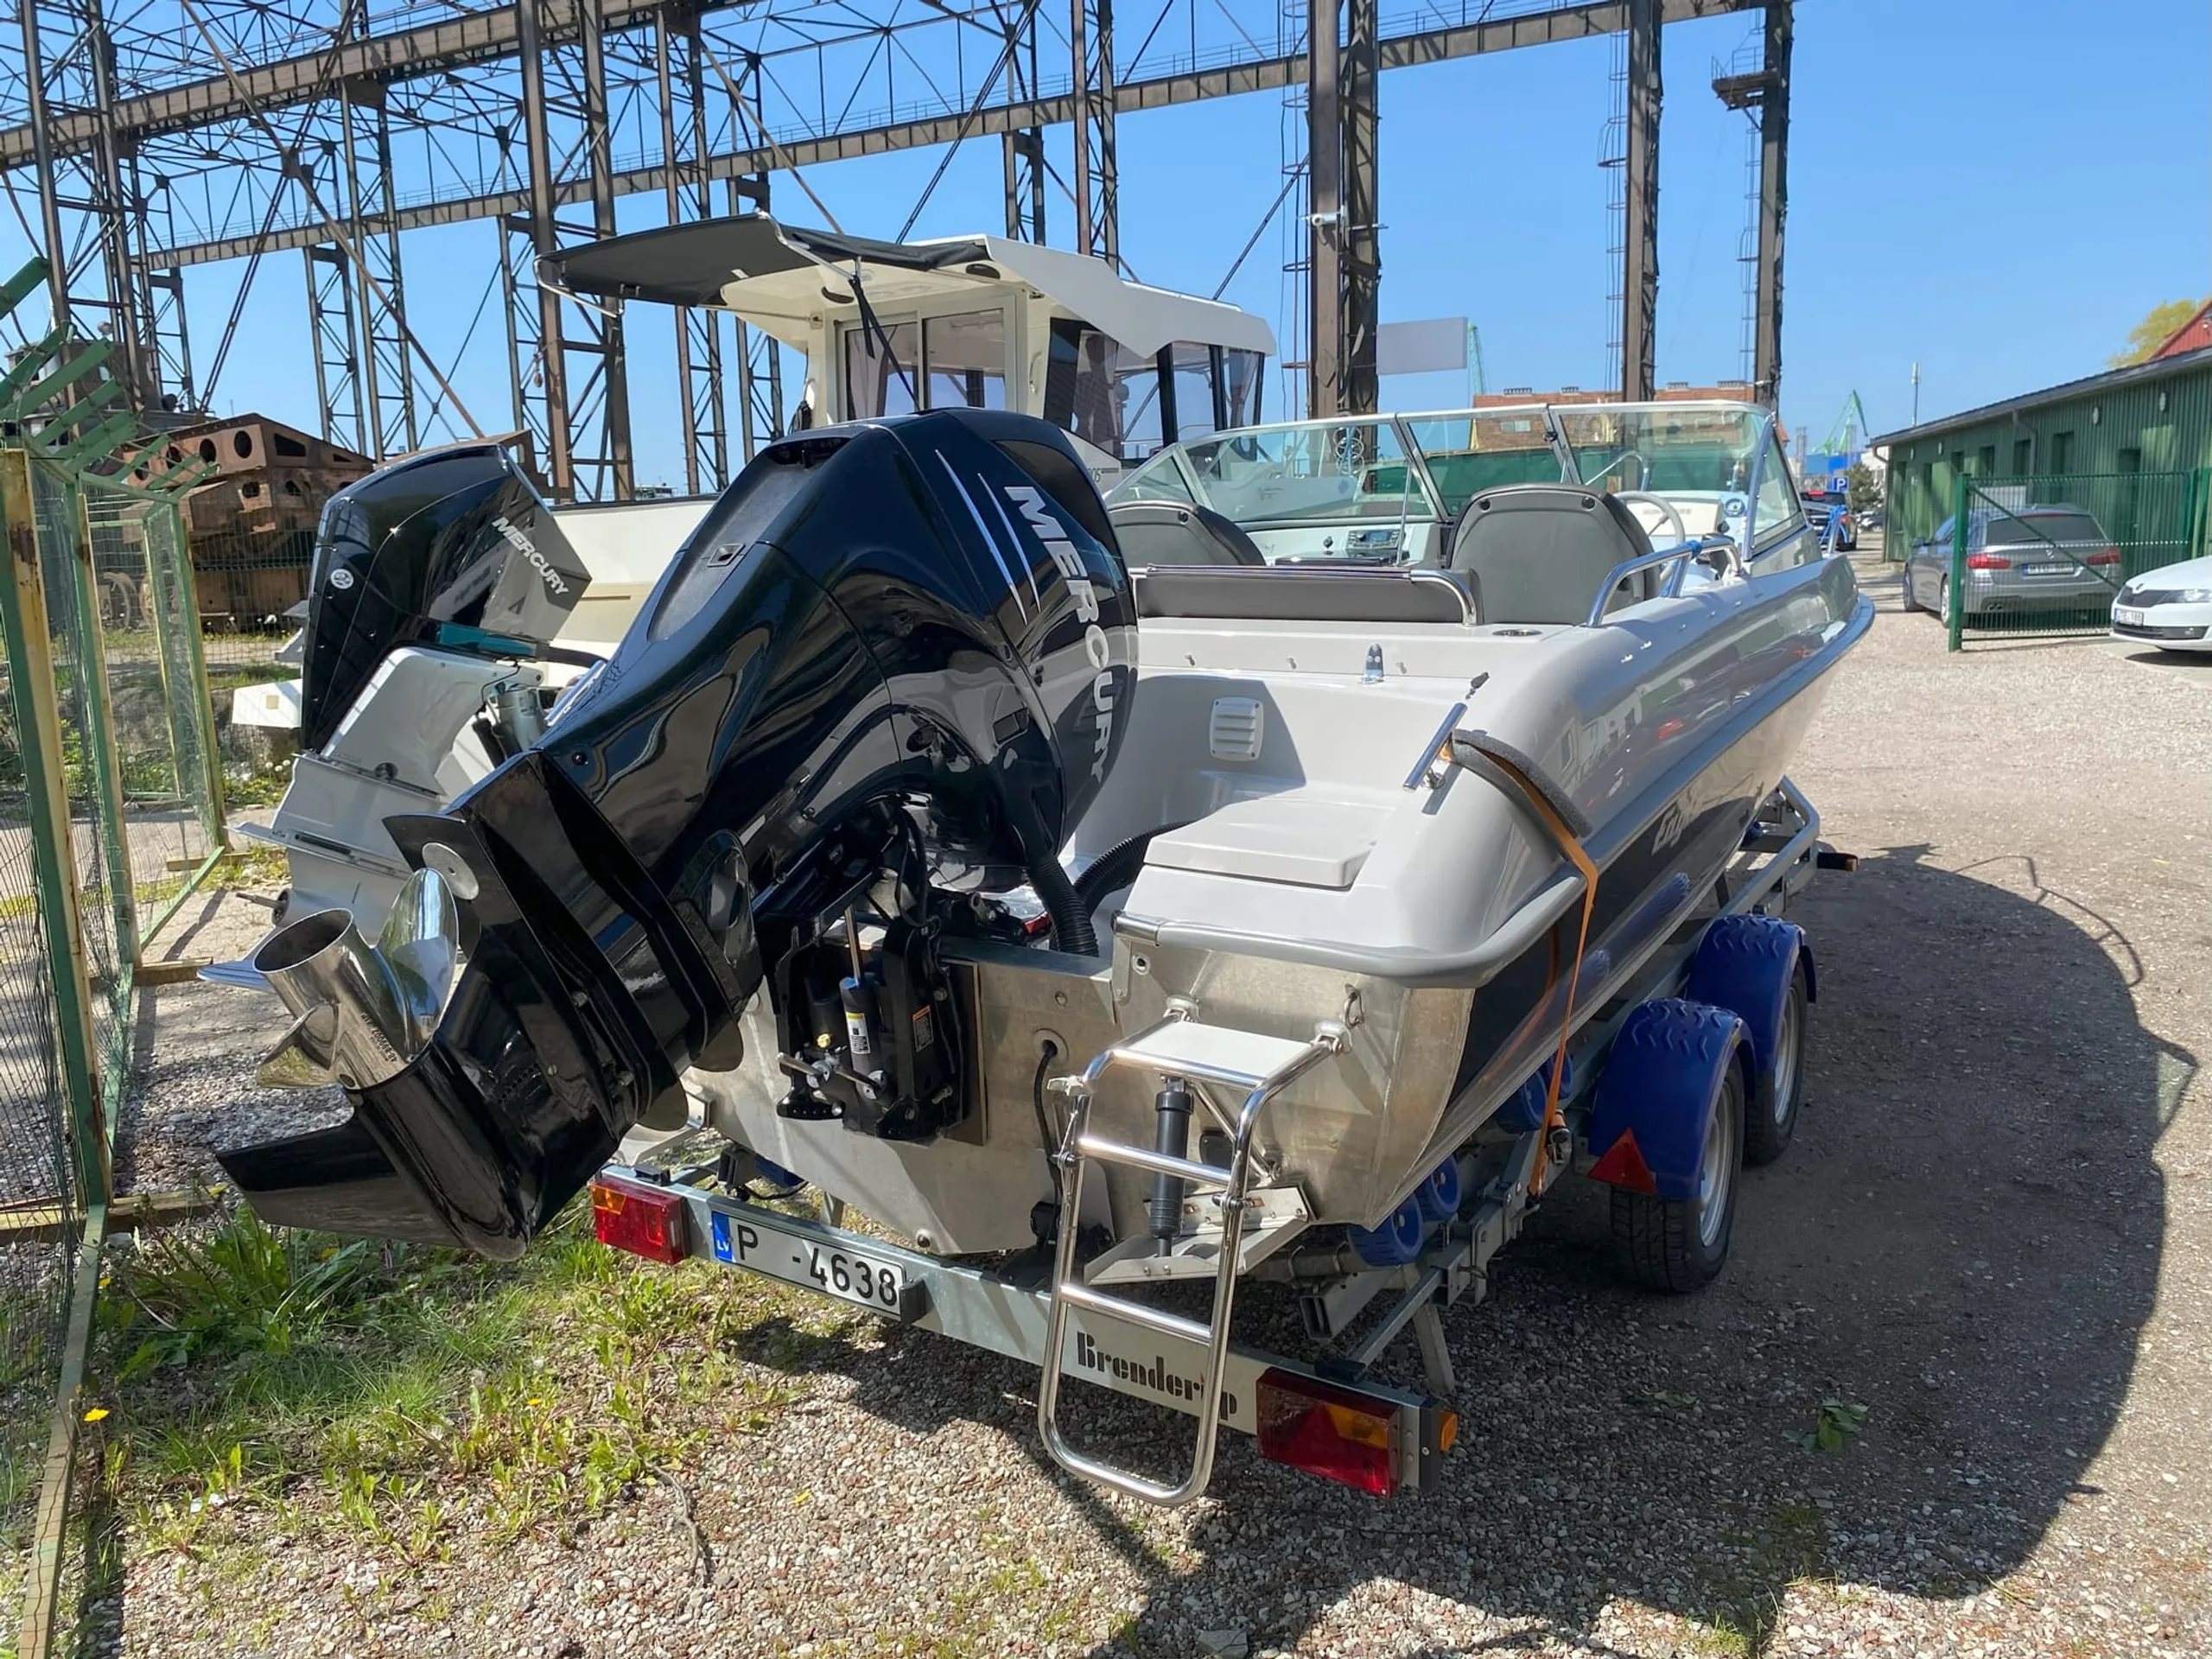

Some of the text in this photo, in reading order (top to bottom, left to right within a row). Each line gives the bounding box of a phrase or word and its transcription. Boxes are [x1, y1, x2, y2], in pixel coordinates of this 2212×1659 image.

[1836, 478, 1846, 492] P
[492, 517, 569, 594] MERCURY
[1004, 486, 1113, 783] MERCURY
[716, 1239, 730, 1253] LV
[737, 1224, 759, 1261] P
[1077, 1331, 1238, 1421] Brenderp
